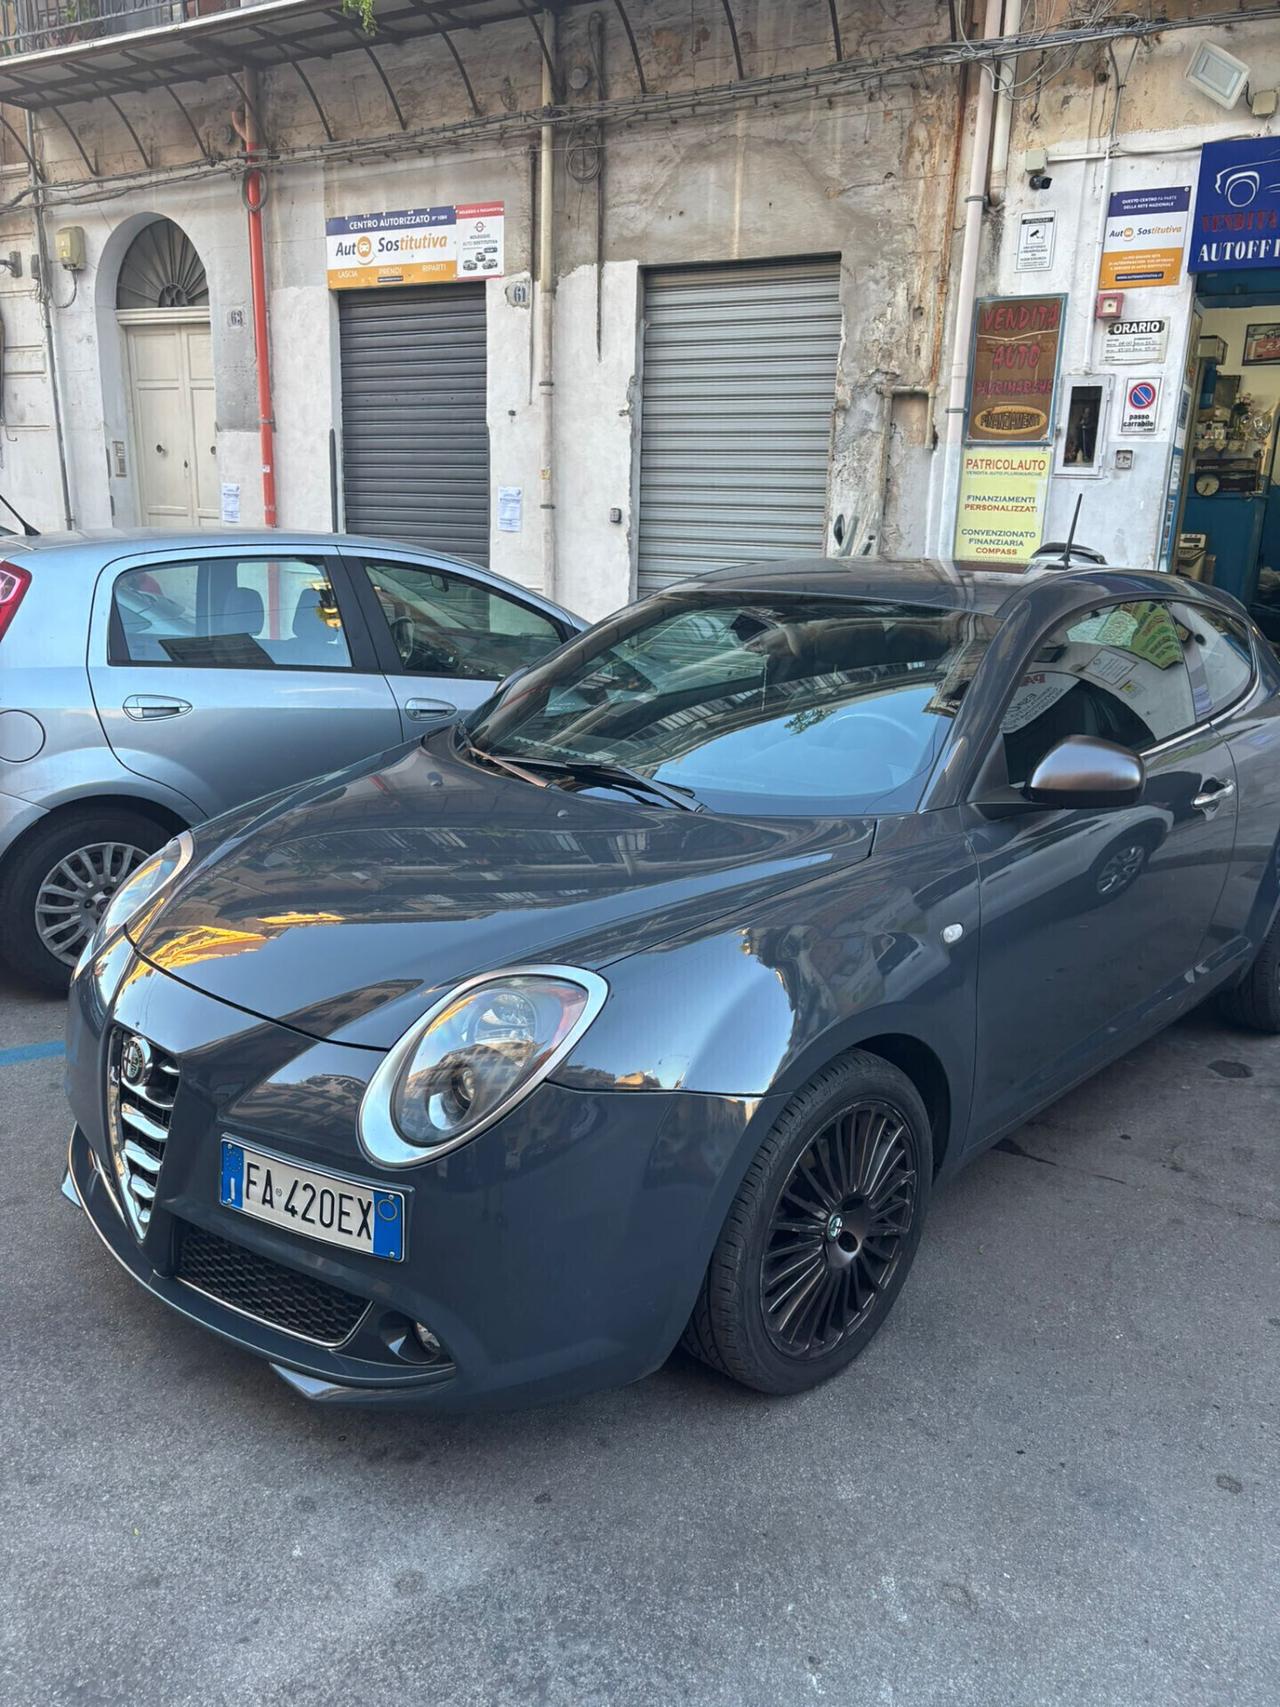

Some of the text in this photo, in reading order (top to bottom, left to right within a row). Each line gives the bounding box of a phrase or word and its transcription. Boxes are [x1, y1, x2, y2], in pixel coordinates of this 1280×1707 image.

[349, 219, 378, 230] CENTRO
[379, 215, 430, 227] AUTORIZZATO
[1137, 225, 1182, 235] Sostitutiva
[378, 232, 448, 253] Sostitutiva
[983, 299, 1059, 331] VENDITA
[1113, 321, 1160, 334] ORARIO
[992, 344, 1041, 369] AUTO
[1123, 420, 1154, 428] carrabile
[966, 458, 1046, 471] PATRICOLAUTO
[967, 495, 1036, 503] FINANZIAMENTI
[964, 504, 1037, 512] PERSONALIZZATI
[961, 529, 1036, 538] CONVENZIONATO
[968, 538, 1024, 547] FINANZIARIA
[976, 547, 1017, 555] COMPASS
